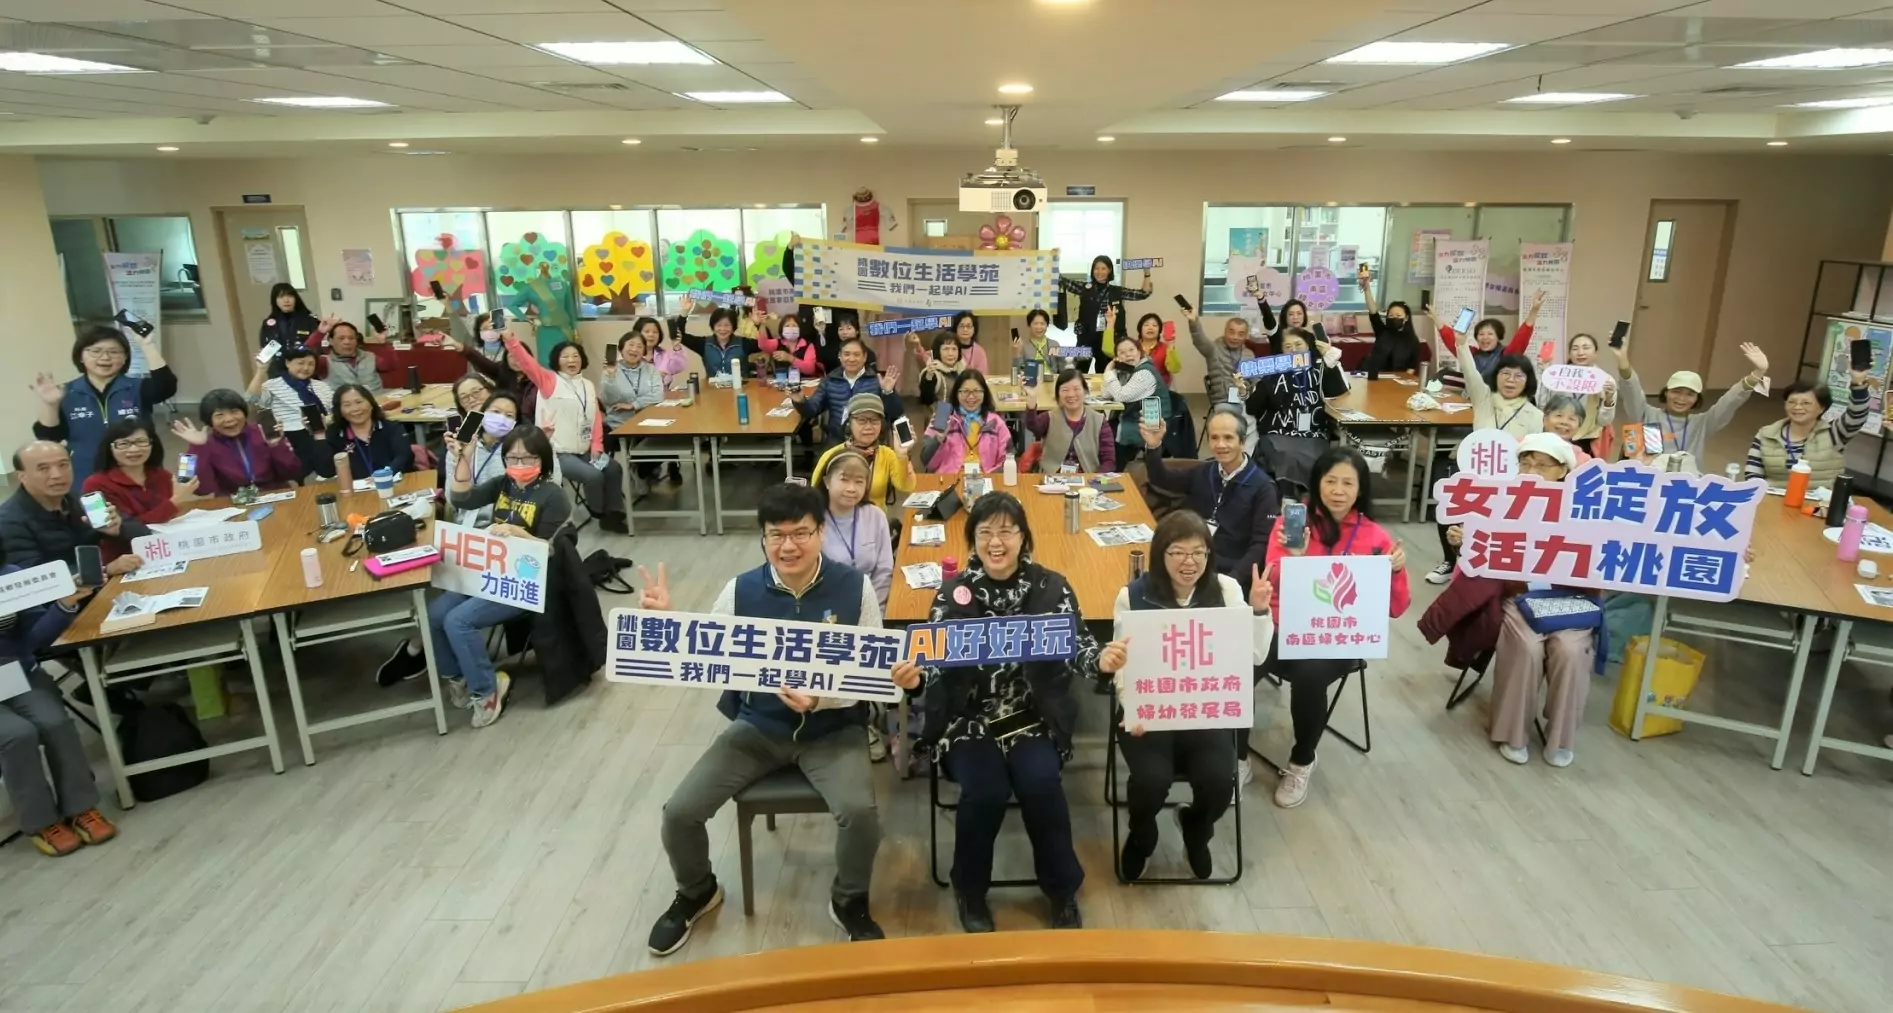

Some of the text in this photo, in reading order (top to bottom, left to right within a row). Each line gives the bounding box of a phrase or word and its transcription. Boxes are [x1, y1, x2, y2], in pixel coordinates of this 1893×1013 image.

[869, 259, 1000, 282] 數位生活學苑
[890, 282, 967, 296] 我們一起學AI
[869, 316, 952, 336] 我們一起學AI
[1241, 352, 1310, 377] 快樂學AI
[1559, 367, 1584, 378] 自我
[1550, 378, 1597, 392] 不設限
[1444, 465, 1759, 540] 女力綻放
[178, 531, 250, 549] 桃園市政府
[440, 528, 507, 575] HER
[1468, 530, 1738, 594] 活力桃園
[481, 572, 539, 605] 力前進
[616, 614, 638, 651] 桃園
[1310, 616, 1358, 629] 桃園市
[640, 617, 900, 670] 數位生活學苑
[908, 619, 1072, 662] AI好好玩
[1285, 632, 1382, 645] 南區婦女中心
[680, 661, 834, 691] 我們一起學AI
[1135, 675, 1242, 694] 桃園市政府
[1136, 701, 1242, 721] 婦幼發展局
